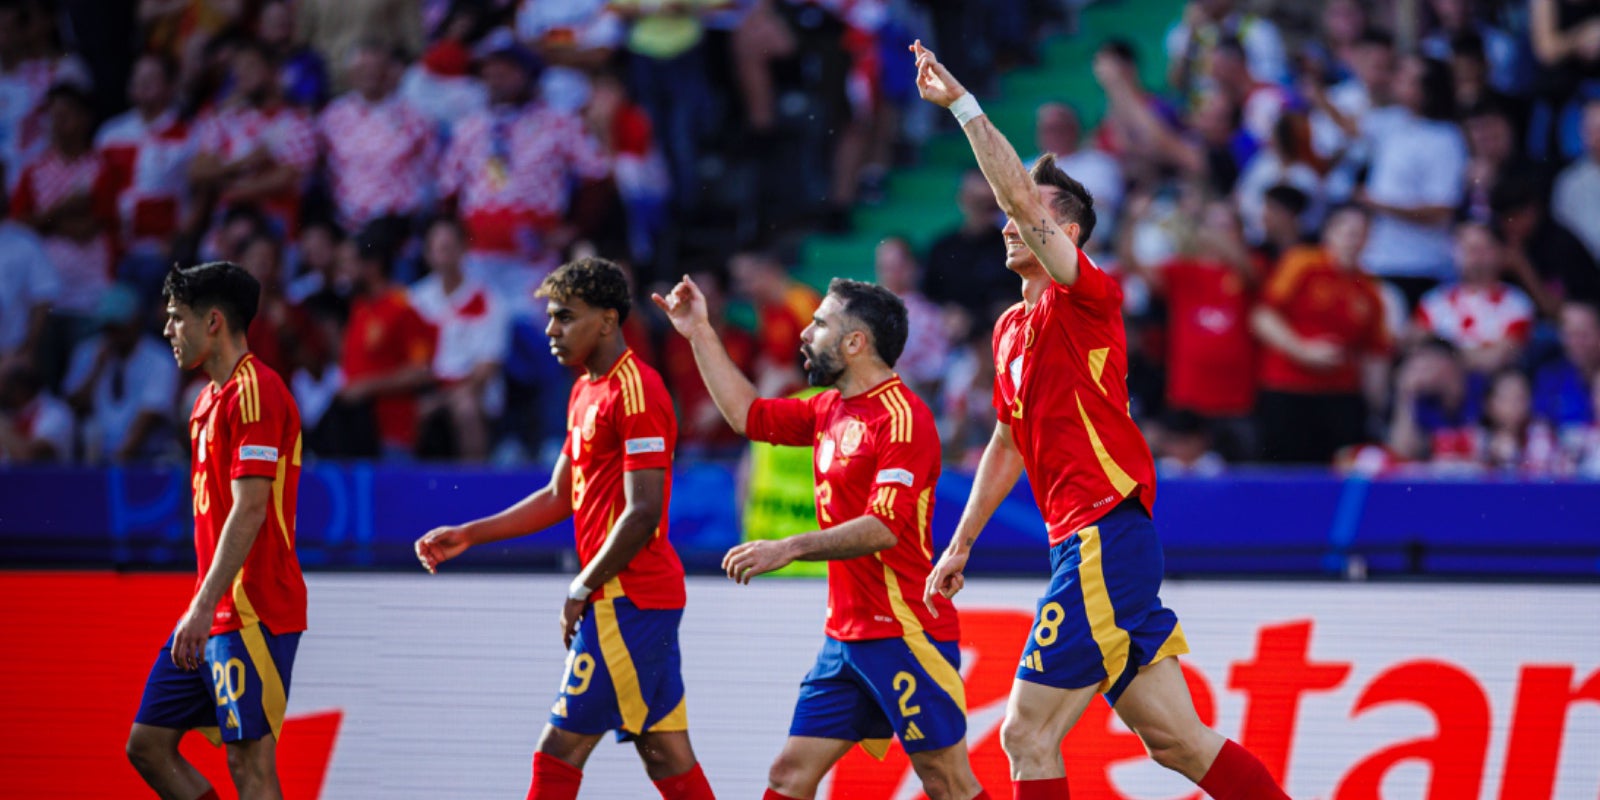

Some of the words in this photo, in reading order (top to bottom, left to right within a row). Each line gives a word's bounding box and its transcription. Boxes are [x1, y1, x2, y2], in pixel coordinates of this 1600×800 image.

[1034, 601, 1065, 648] 8
[213, 658, 246, 707] 20
[559, 649, 596, 697] 19
[892, 671, 922, 718] 2
